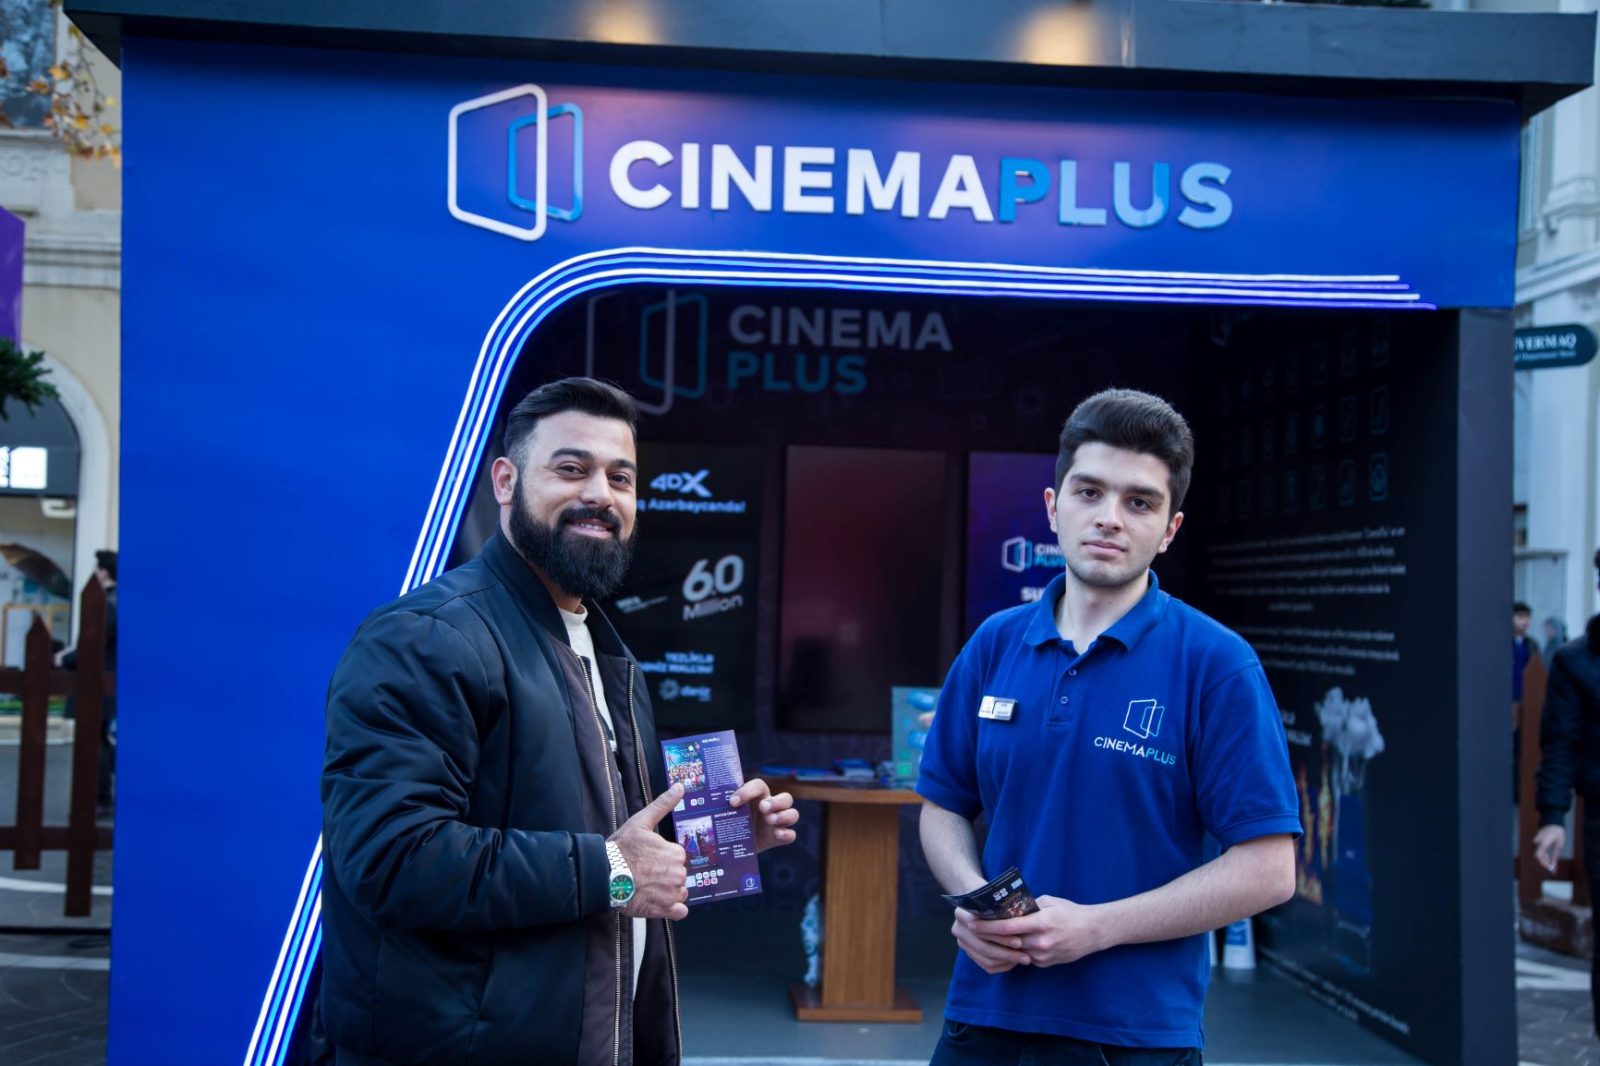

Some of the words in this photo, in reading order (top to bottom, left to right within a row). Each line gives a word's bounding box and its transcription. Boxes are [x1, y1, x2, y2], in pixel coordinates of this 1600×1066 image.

[609, 140, 1233, 229] CINEMAPLUS
[729, 304, 953, 351] CINEMA
[726, 351, 867, 394] PLUS
[649, 469, 713, 498] 4DX
[683, 594, 744, 621] Million
[1093, 736, 1177, 766] CINEMAPLUS
